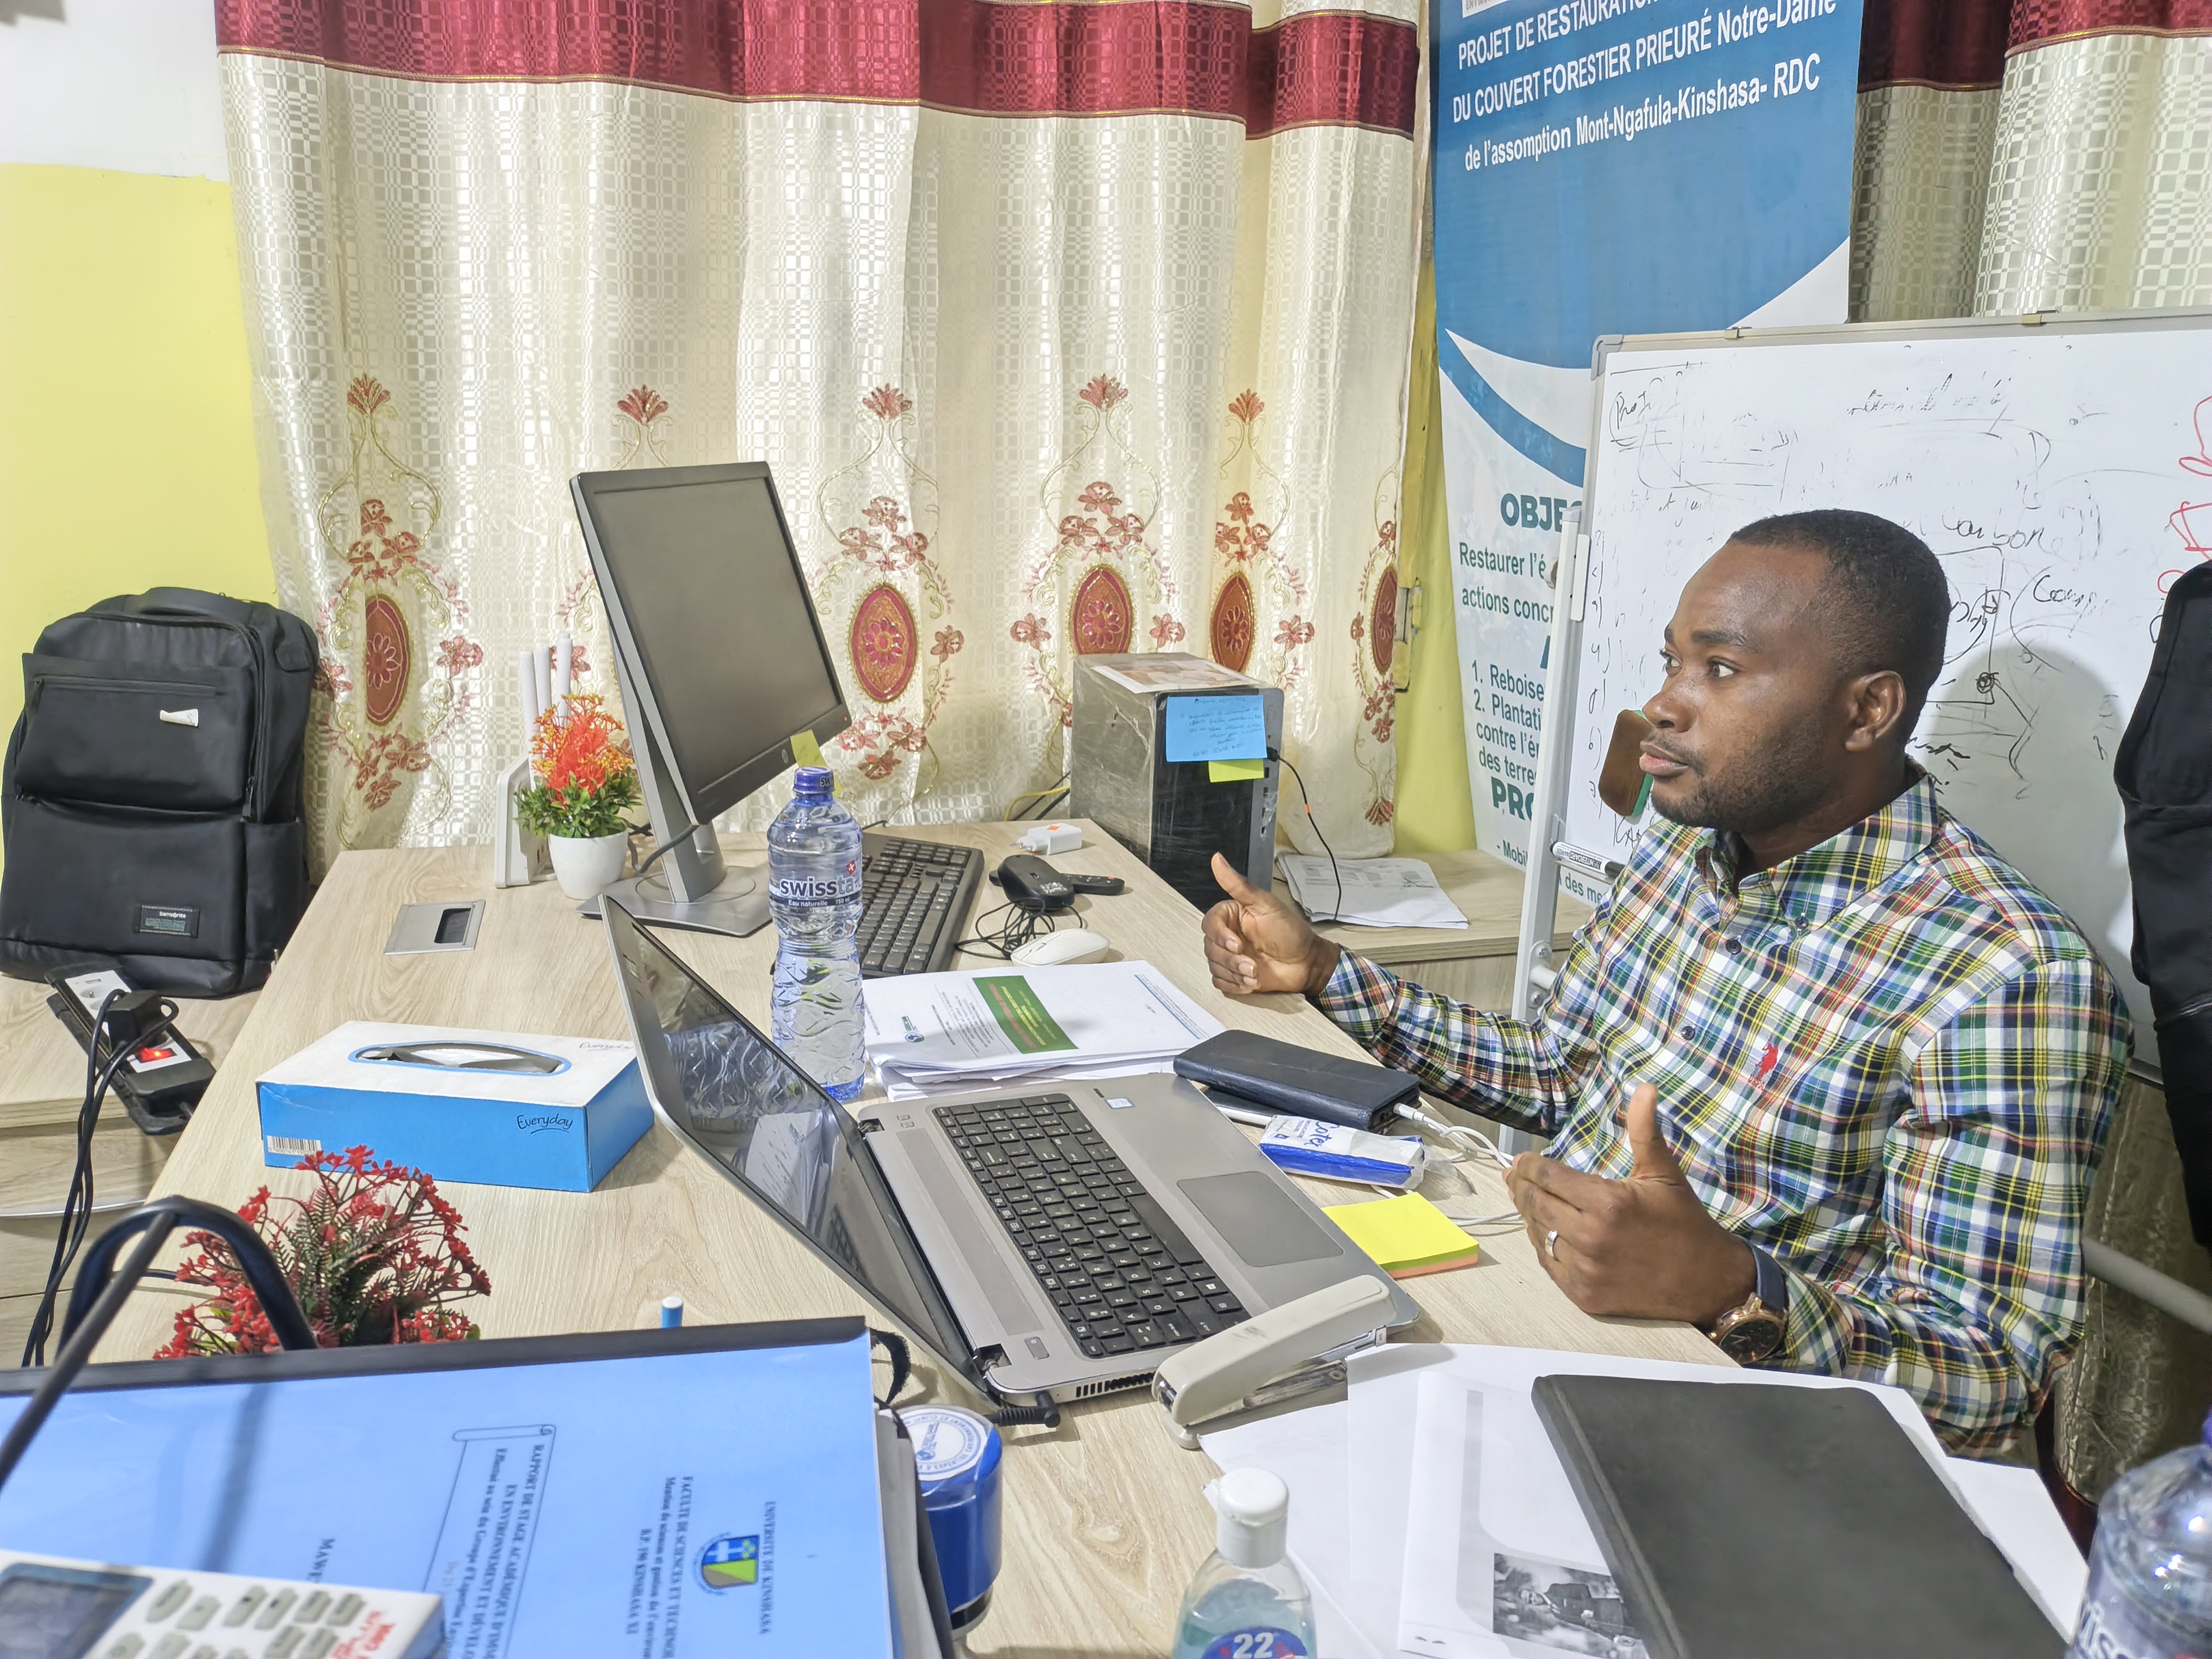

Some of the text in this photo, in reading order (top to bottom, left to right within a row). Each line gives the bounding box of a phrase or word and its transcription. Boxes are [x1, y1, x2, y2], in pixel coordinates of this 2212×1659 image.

[1453, 0, 1836, 122] DU COUVERT FORESTIER PRIEURÉ Notre-Dame
[1459, 26, 1511, 70] PROJET
[1516, 17, 1535, 51] DE
[1465, 144, 1480, 171] de
[1484, 125, 1571, 167] l'assomption
[1774, 53, 1821, 98] RDC
[1501, 493, 1583, 533] OBJE
[1459, 542, 1525, 576] Restaurer
[1462, 586, 1509, 615] actions
[1472, 660, 1544, 702] 1. Reboise
[1473, 689, 1485, 712] 2.
[1476, 722, 1516, 751] contre
[1479, 746, 1536, 787] des terre
[1565, 872, 1584, 896] des
[517, 1113, 573, 1129] Everyday
